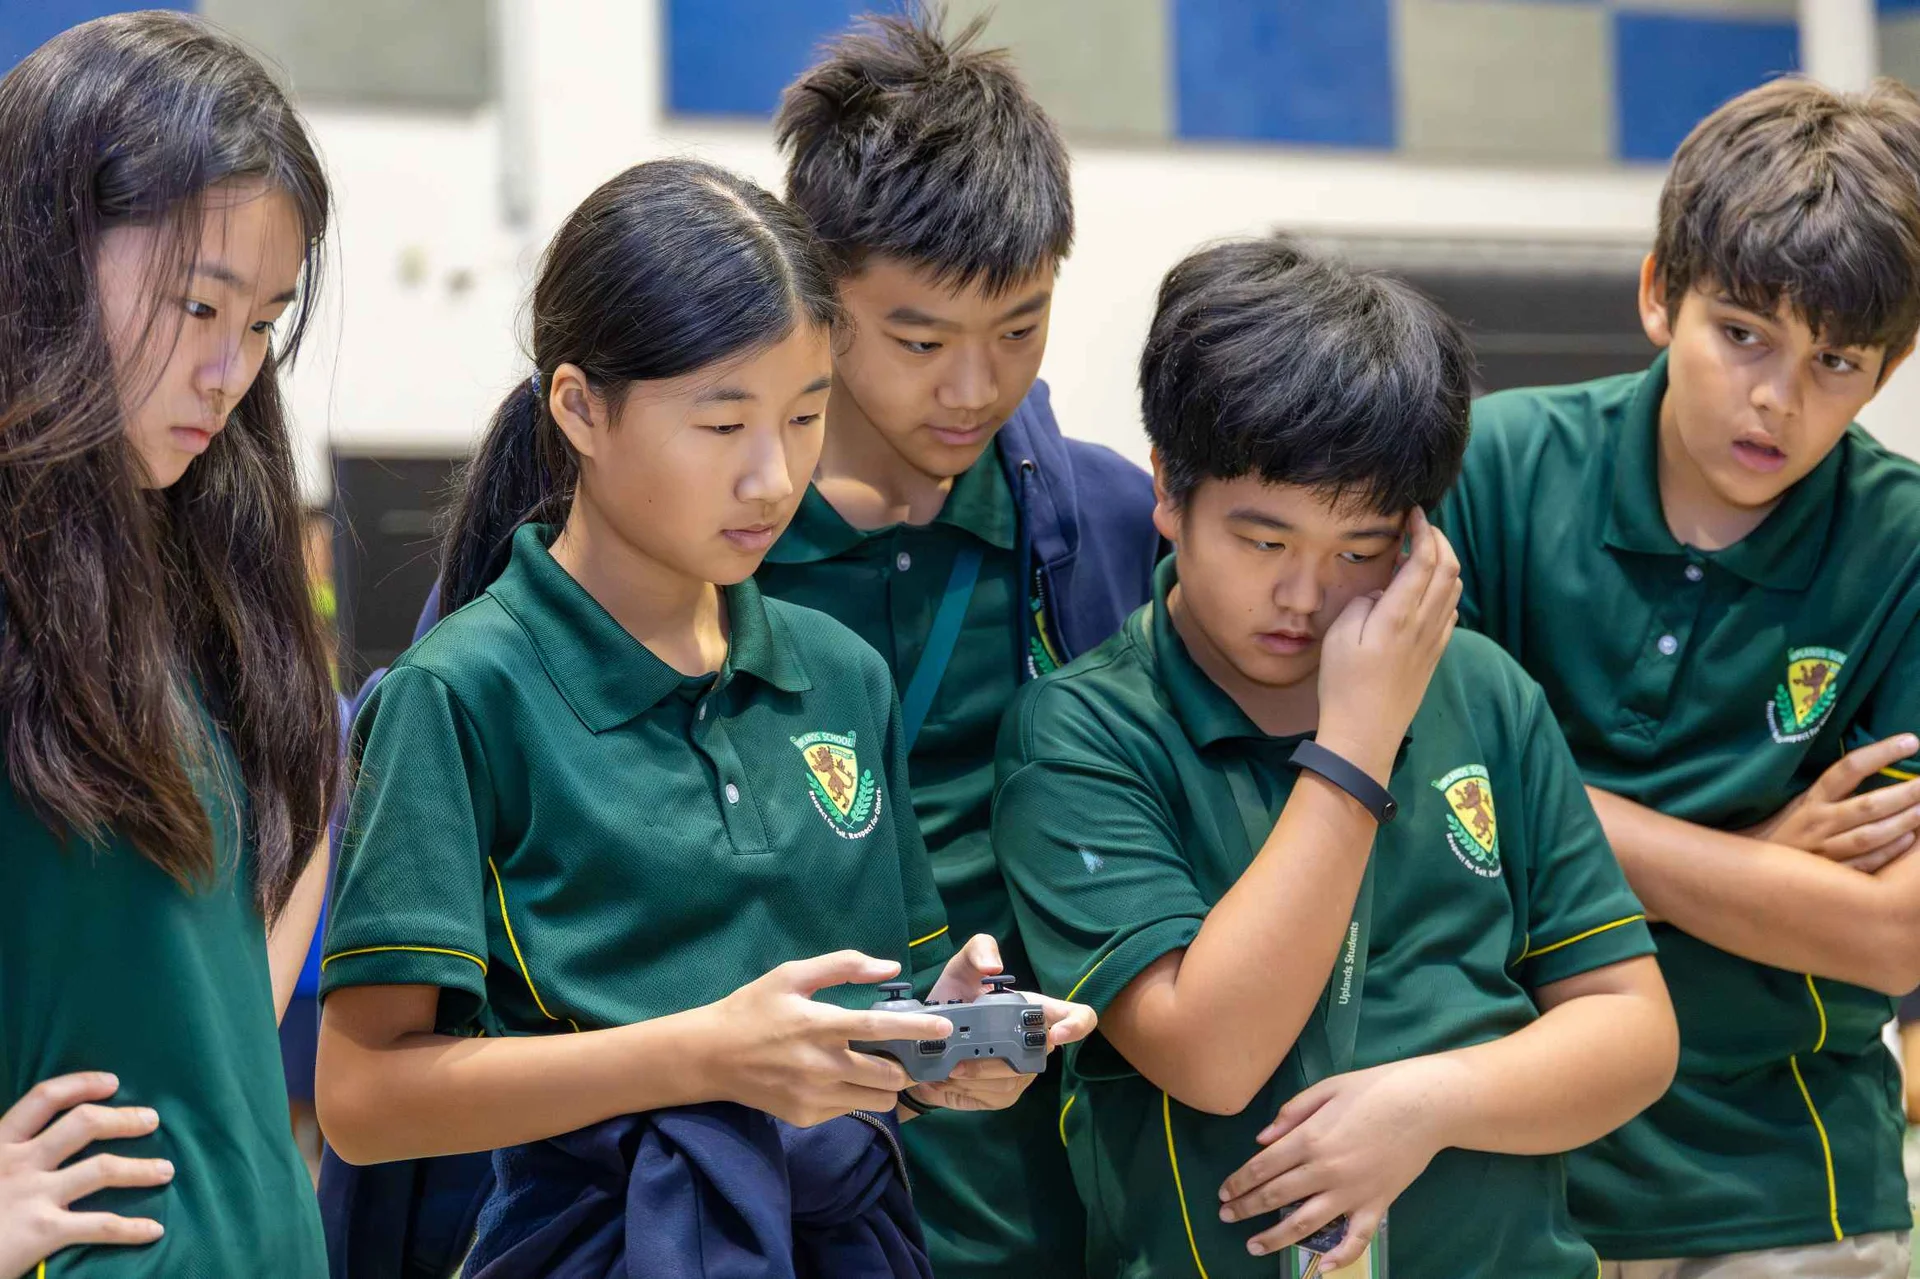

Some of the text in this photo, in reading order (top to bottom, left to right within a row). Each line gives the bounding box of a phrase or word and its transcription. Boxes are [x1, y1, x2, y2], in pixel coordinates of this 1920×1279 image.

[822, 732, 853, 747] SCHOOL
[809, 790, 827, 820] Respect
[849, 824, 874, 839] Respect
[1338, 921, 1359, 1005] Uplands Students
